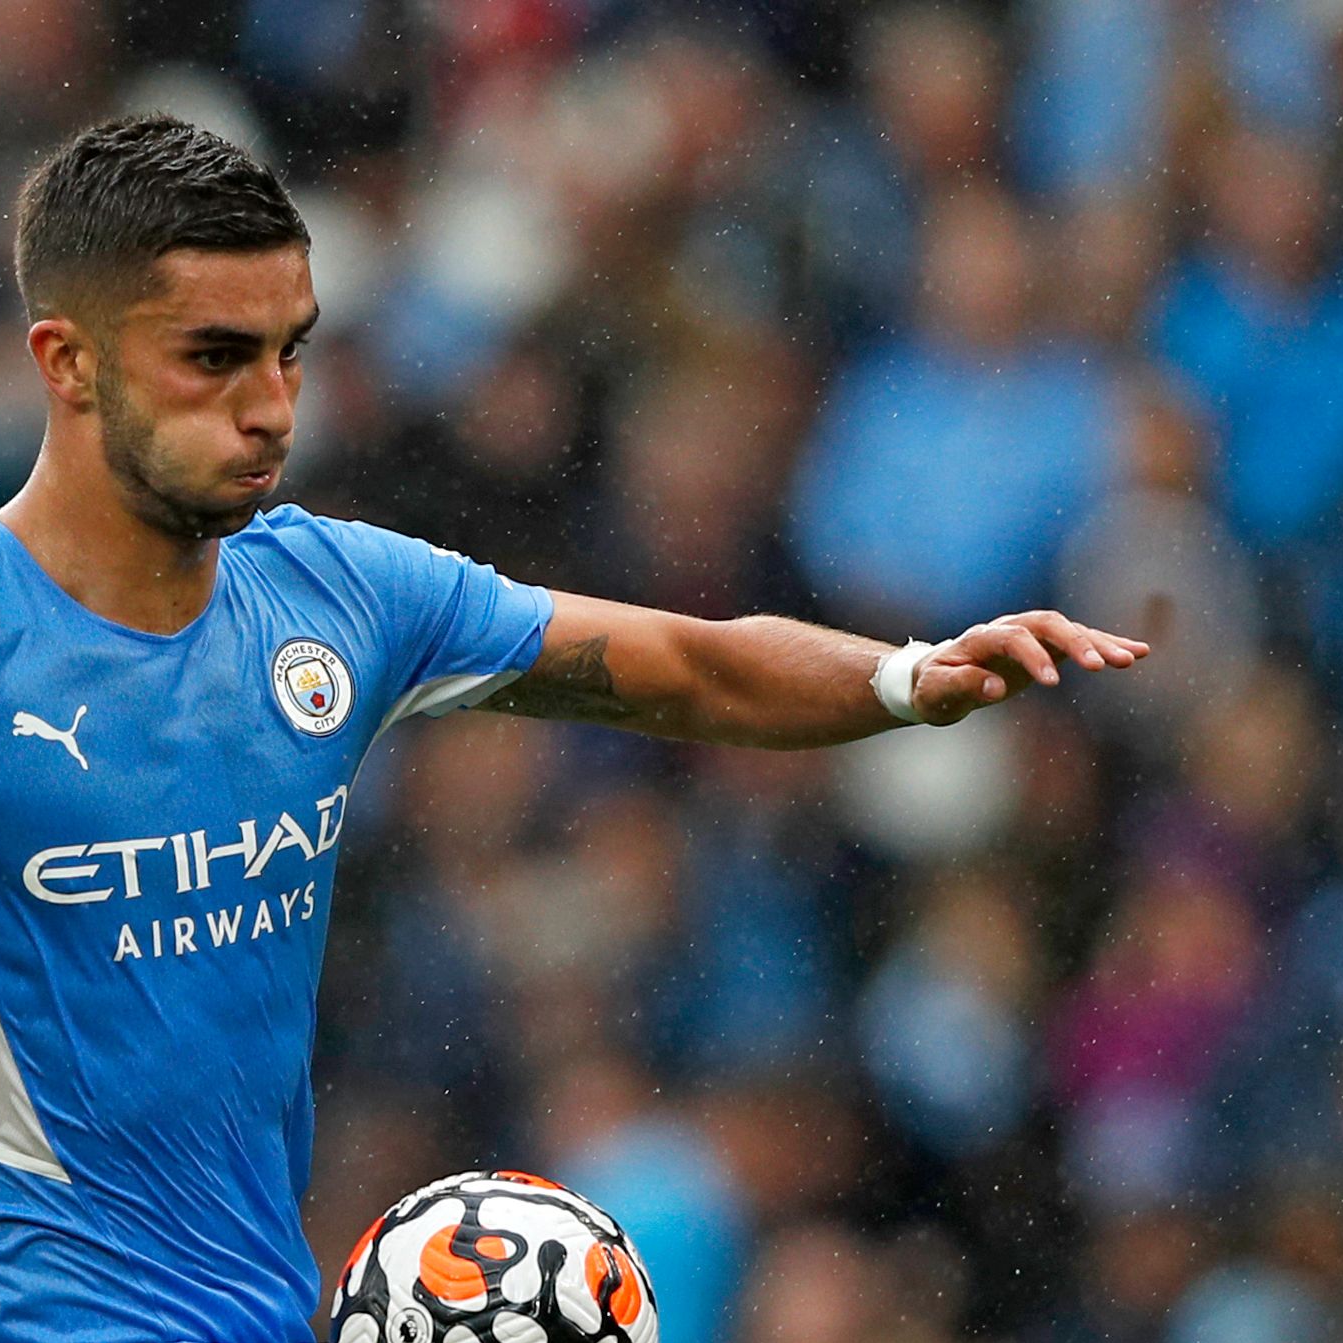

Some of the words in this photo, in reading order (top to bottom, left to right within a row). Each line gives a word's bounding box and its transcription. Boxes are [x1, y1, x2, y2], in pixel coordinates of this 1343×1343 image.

[276, 645, 336, 682] MANCHESTER
[314, 716, 336, 730] CITY
[22, 784, 348, 904] ETIHAD
[113, 880, 315, 962] AIRWAYS
